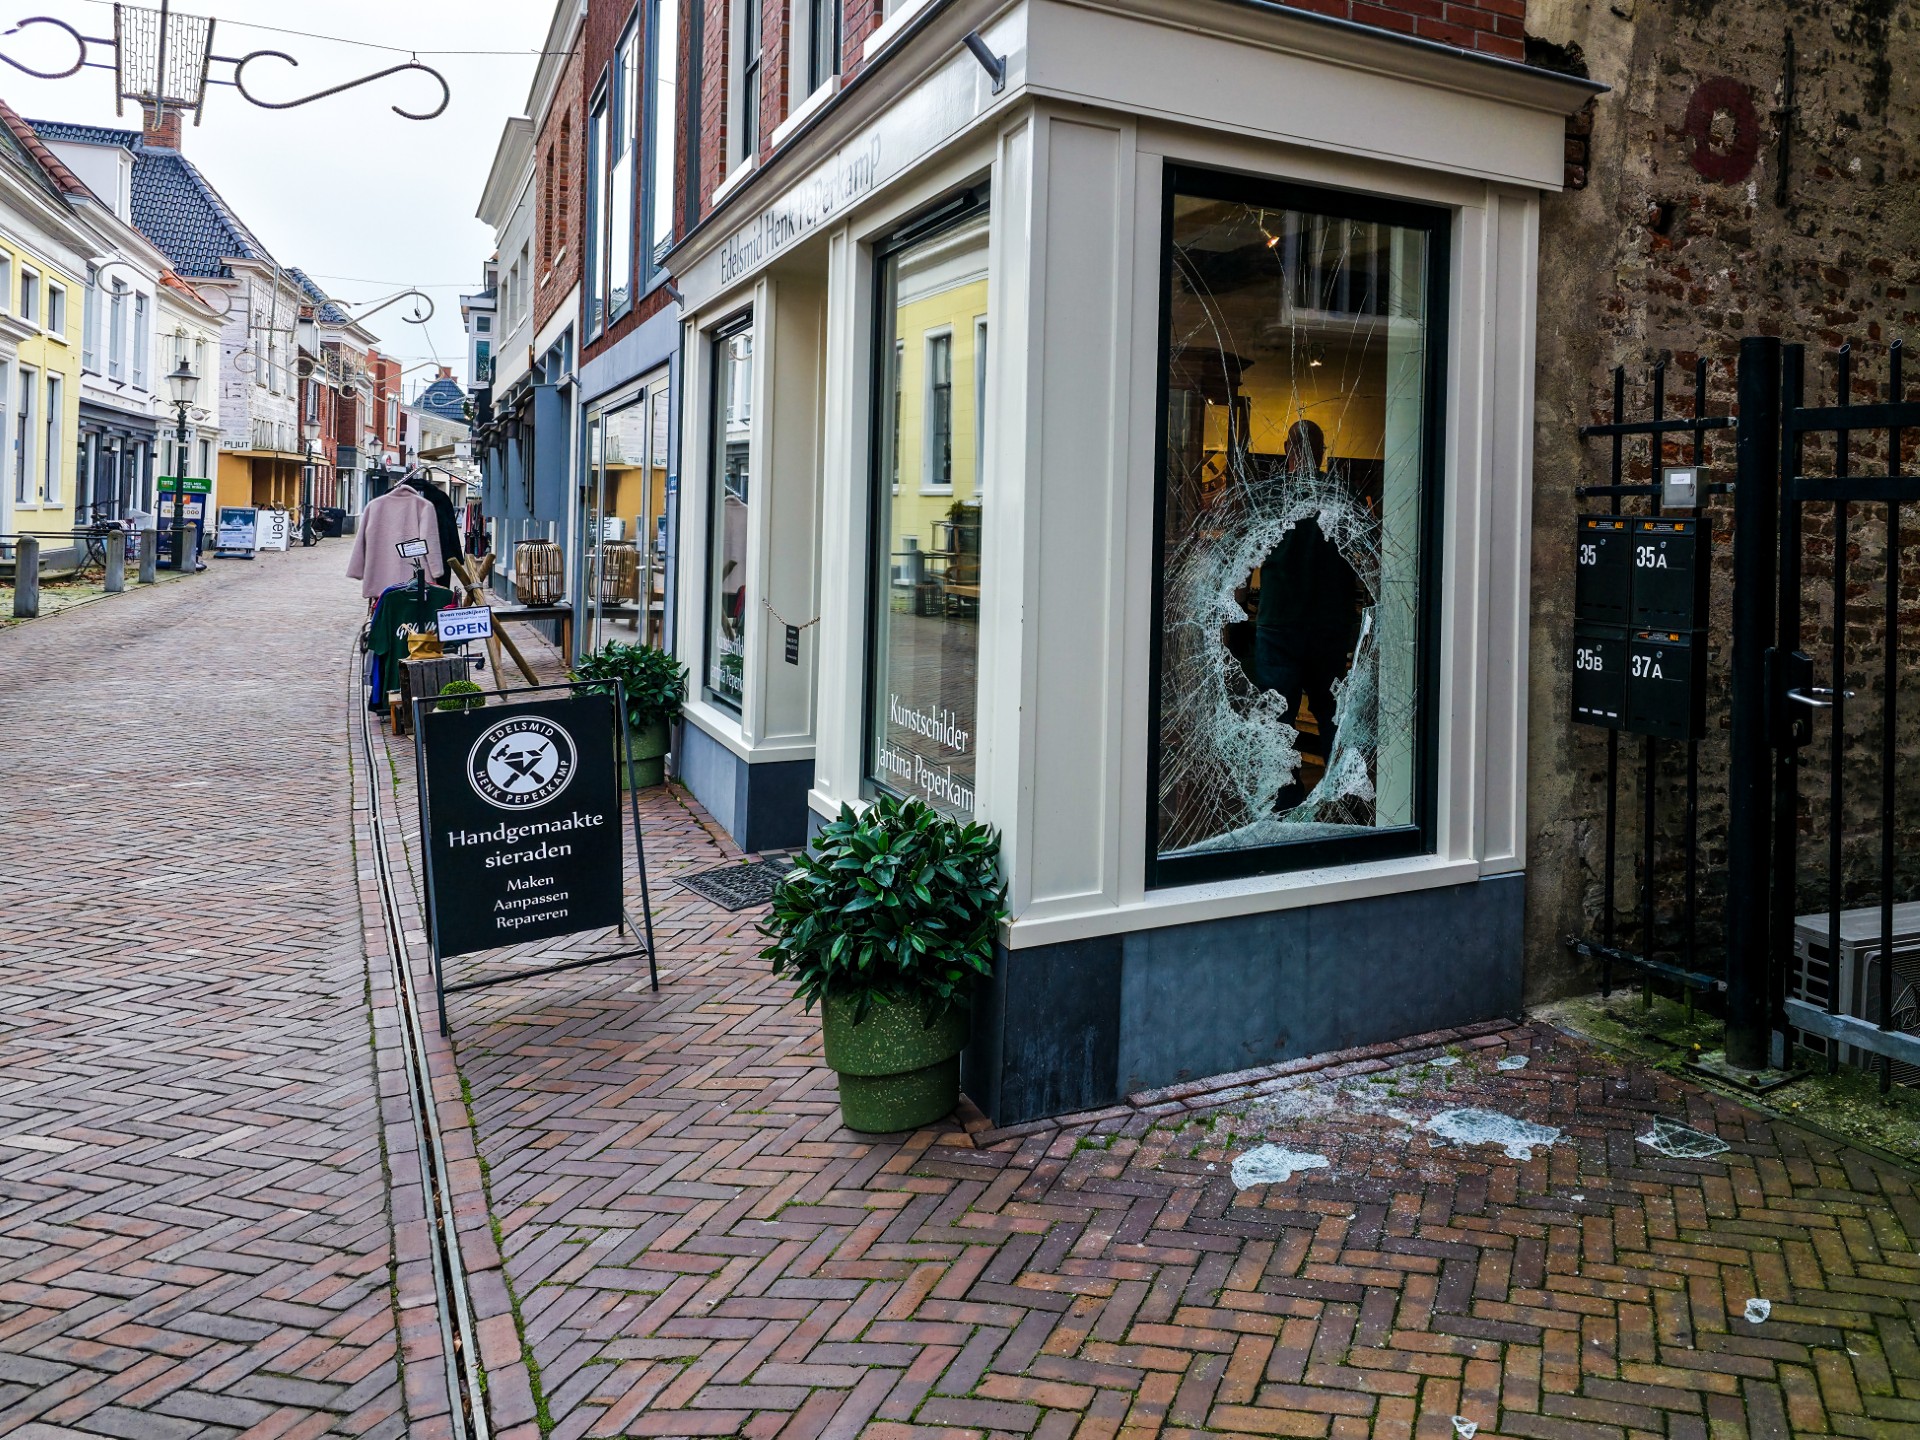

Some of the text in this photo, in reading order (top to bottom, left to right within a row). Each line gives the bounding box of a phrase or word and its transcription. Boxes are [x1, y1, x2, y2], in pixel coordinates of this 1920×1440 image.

[721, 132, 882, 286] Edelsmid Henk Peperkamp
[1580, 544, 1597, 566] 35
[1636, 545, 1668, 569] 35A
[444, 621, 488, 636] OPEN
[1576, 648, 1603, 671] 35B
[1631, 655, 1663, 679] 37A
[488, 722, 554, 743] EDELSMID
[890, 693, 969, 752] Kunstschilder
[476, 760, 570, 804] HENK PEPERKAMP
[875, 736, 975, 813] Jantina Peperkam
[447, 811, 604, 848] Handgemaakte
[485, 841, 572, 868] sieraden
[506, 875, 555, 892] Maken
[493, 891, 569, 912] Aanpassen
[496, 908, 569, 929] Repareren
